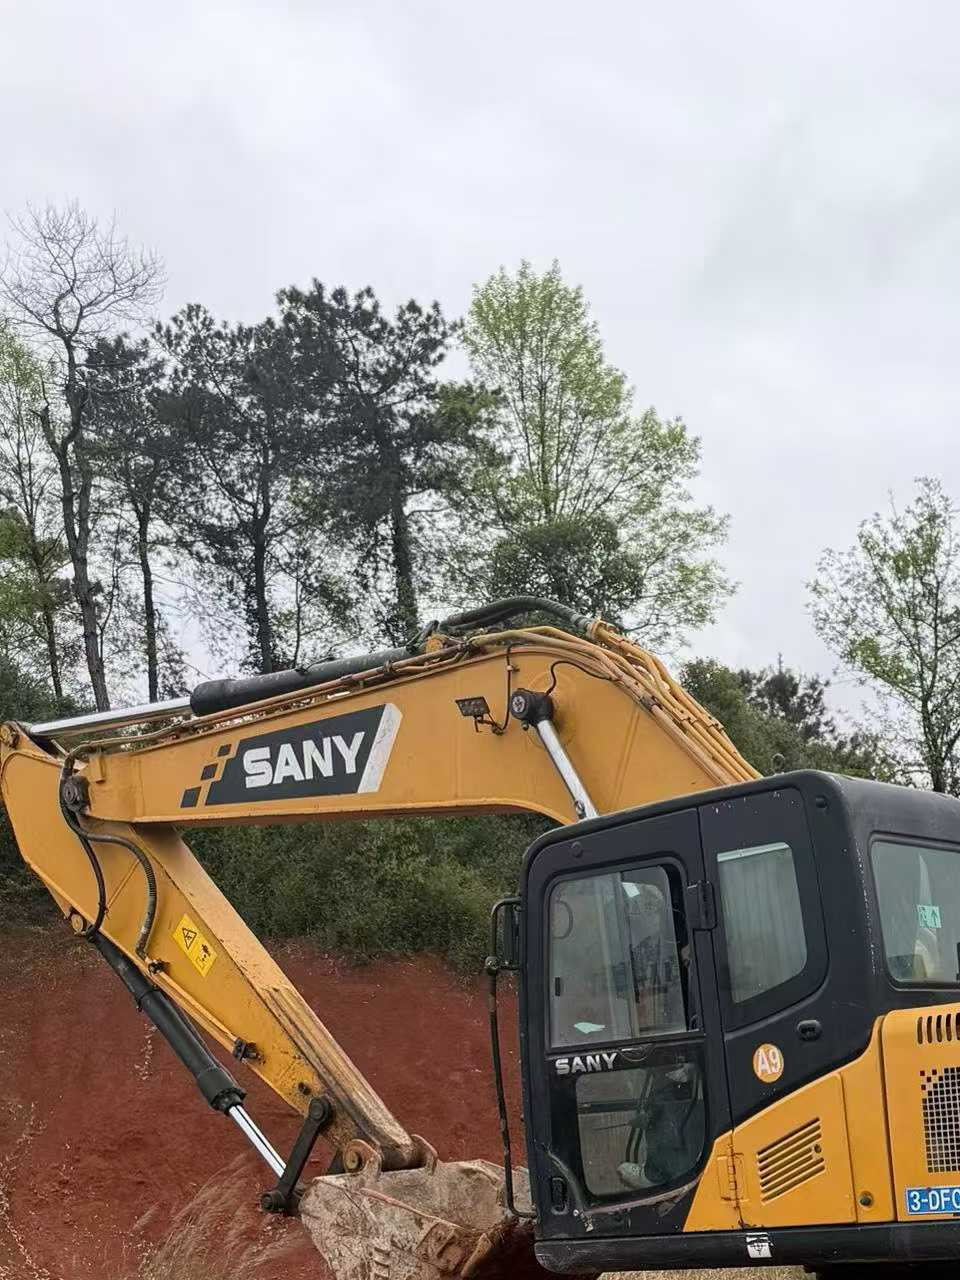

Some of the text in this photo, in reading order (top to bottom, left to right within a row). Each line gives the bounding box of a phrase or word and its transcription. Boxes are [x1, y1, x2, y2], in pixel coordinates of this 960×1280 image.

[244, 731, 366, 788] SANY
[555, 1052, 617, 1075] SANY
[758, 1049, 780, 1074] A9
